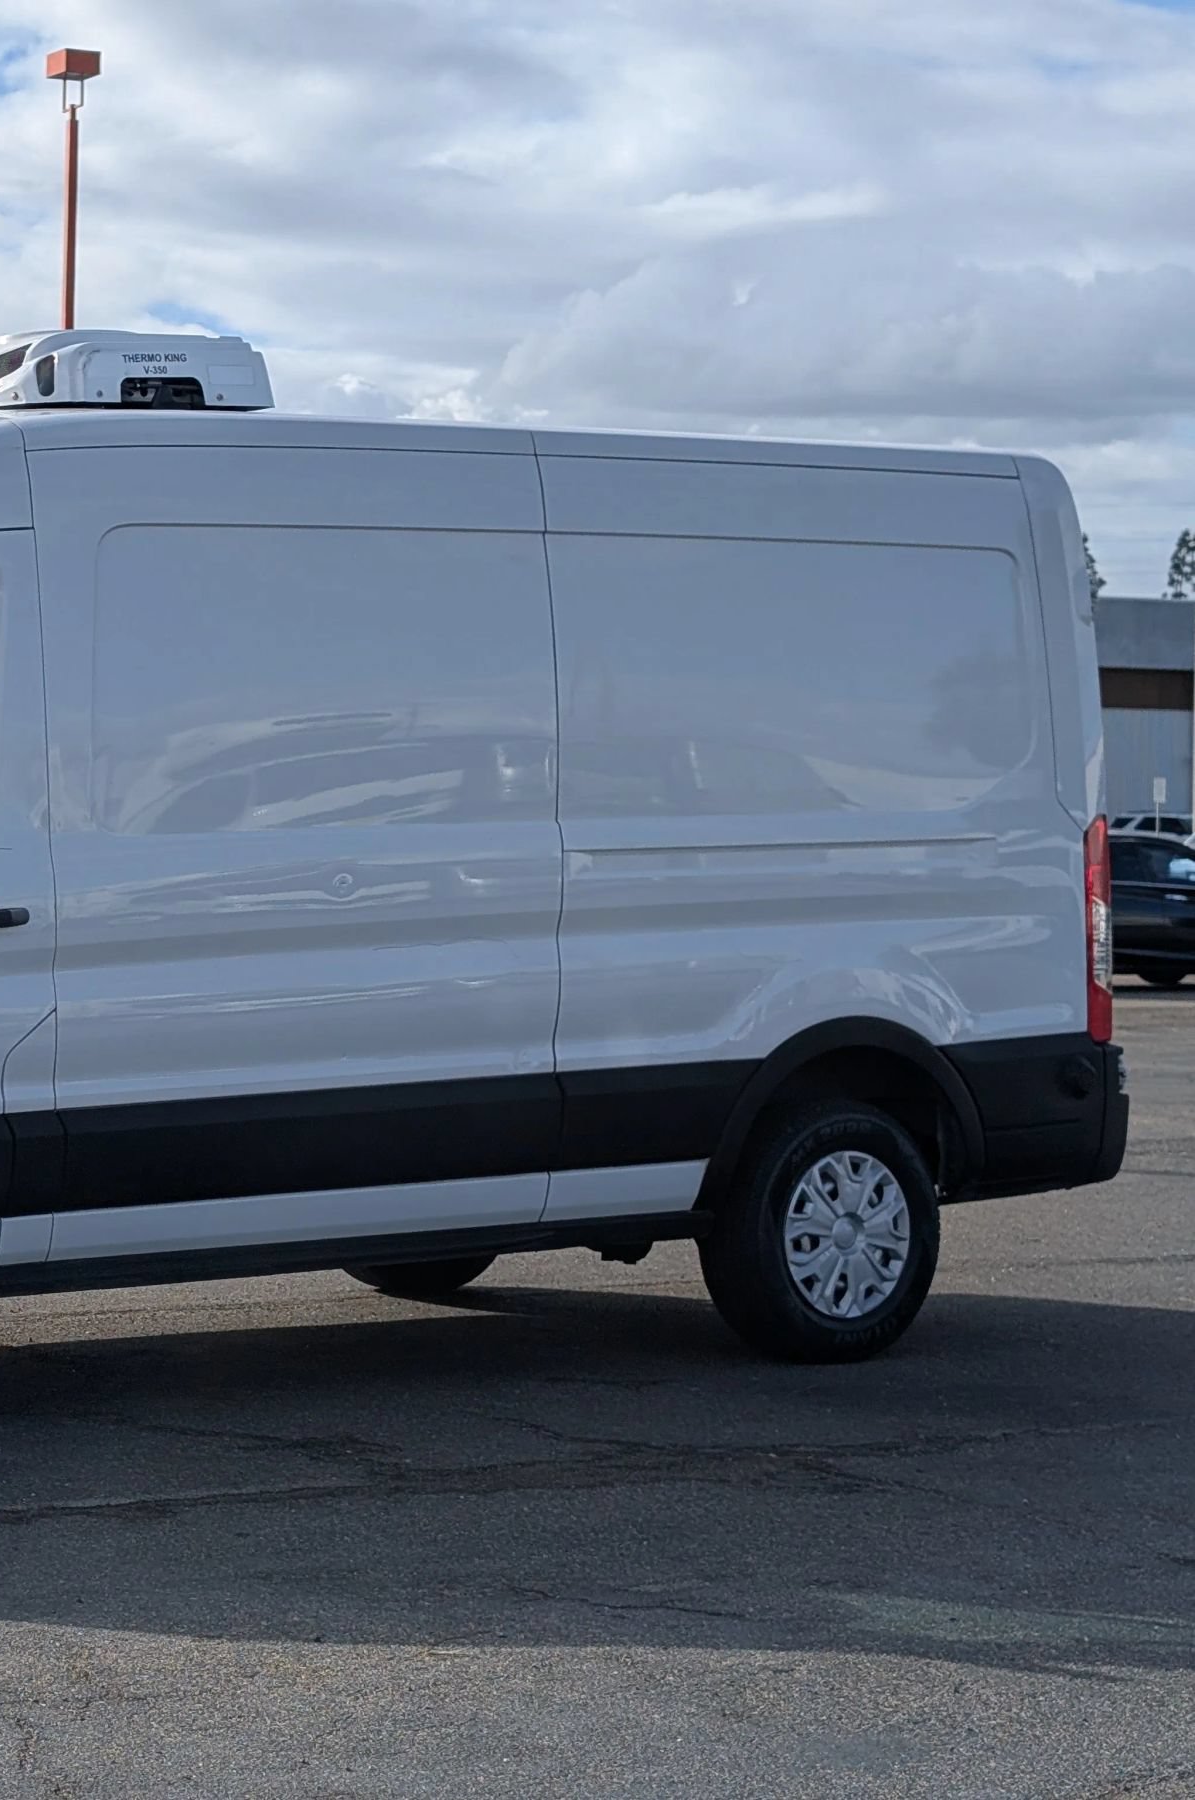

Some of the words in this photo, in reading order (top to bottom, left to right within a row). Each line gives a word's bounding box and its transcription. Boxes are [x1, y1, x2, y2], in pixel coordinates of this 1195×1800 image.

[122, 353, 162, 363] THERMO
[164, 353, 188, 363] KING
[143, 365, 168, 375] V-350
